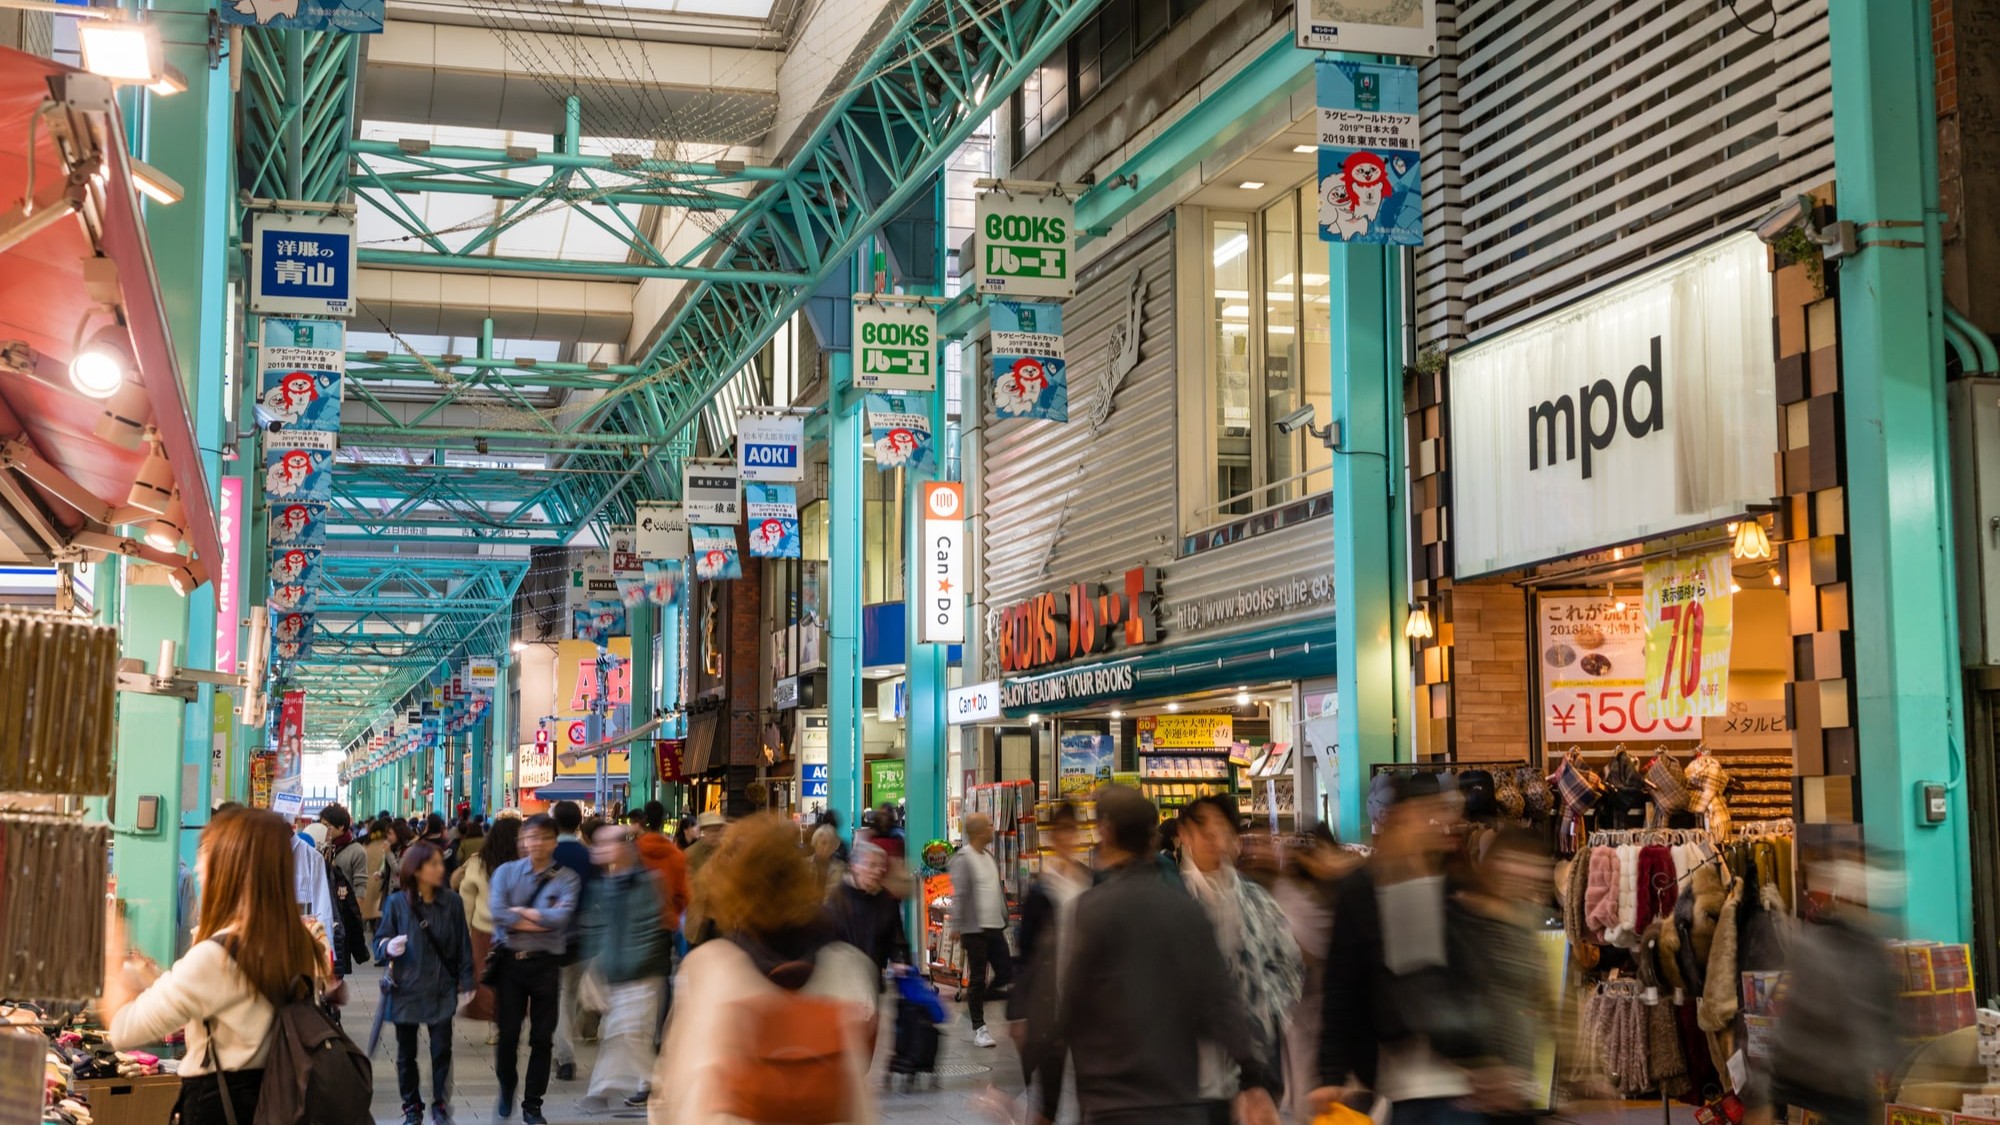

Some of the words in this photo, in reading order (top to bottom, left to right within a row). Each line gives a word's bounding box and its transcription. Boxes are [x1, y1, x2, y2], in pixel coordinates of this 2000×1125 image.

[1324, 110, 1411, 125] ラグビーワールドカップ
[1339, 123, 1399, 135] 2019™日本大会
[985, 213, 1066, 244] BOOKS
[277, 240, 334, 258] 洋服の
[274, 259, 335, 287] 青山
[990, 246, 1061, 277] ルーエ
[862, 322, 929, 347] BOOKS
[997, 333, 1059, 342] ラグビーワールドカップ
[270, 348, 336, 356] ラグビーワールドカップ
[866, 350, 925, 374] ルーエ
[1528, 334, 1664, 480] mpd
[747, 446, 789, 464] AOKI
[935, 493, 953, 508] 100
[937, 536, 951, 574] Can
[937, 598, 951, 625] Do
[1000, 591, 1057, 672] BOOKS
[1660, 600, 1705, 700] 70
[1000, 683, 1026, 709] ENJOY
[1026, 677, 1066, 704] READING
[1066, 672, 1095, 698] YOUR
[1095, 664, 1133, 693] BOOKS
[959, 695, 972, 714] Can
[977, 694, 988, 711] Do
[876, 770, 904, 782] 下取り
